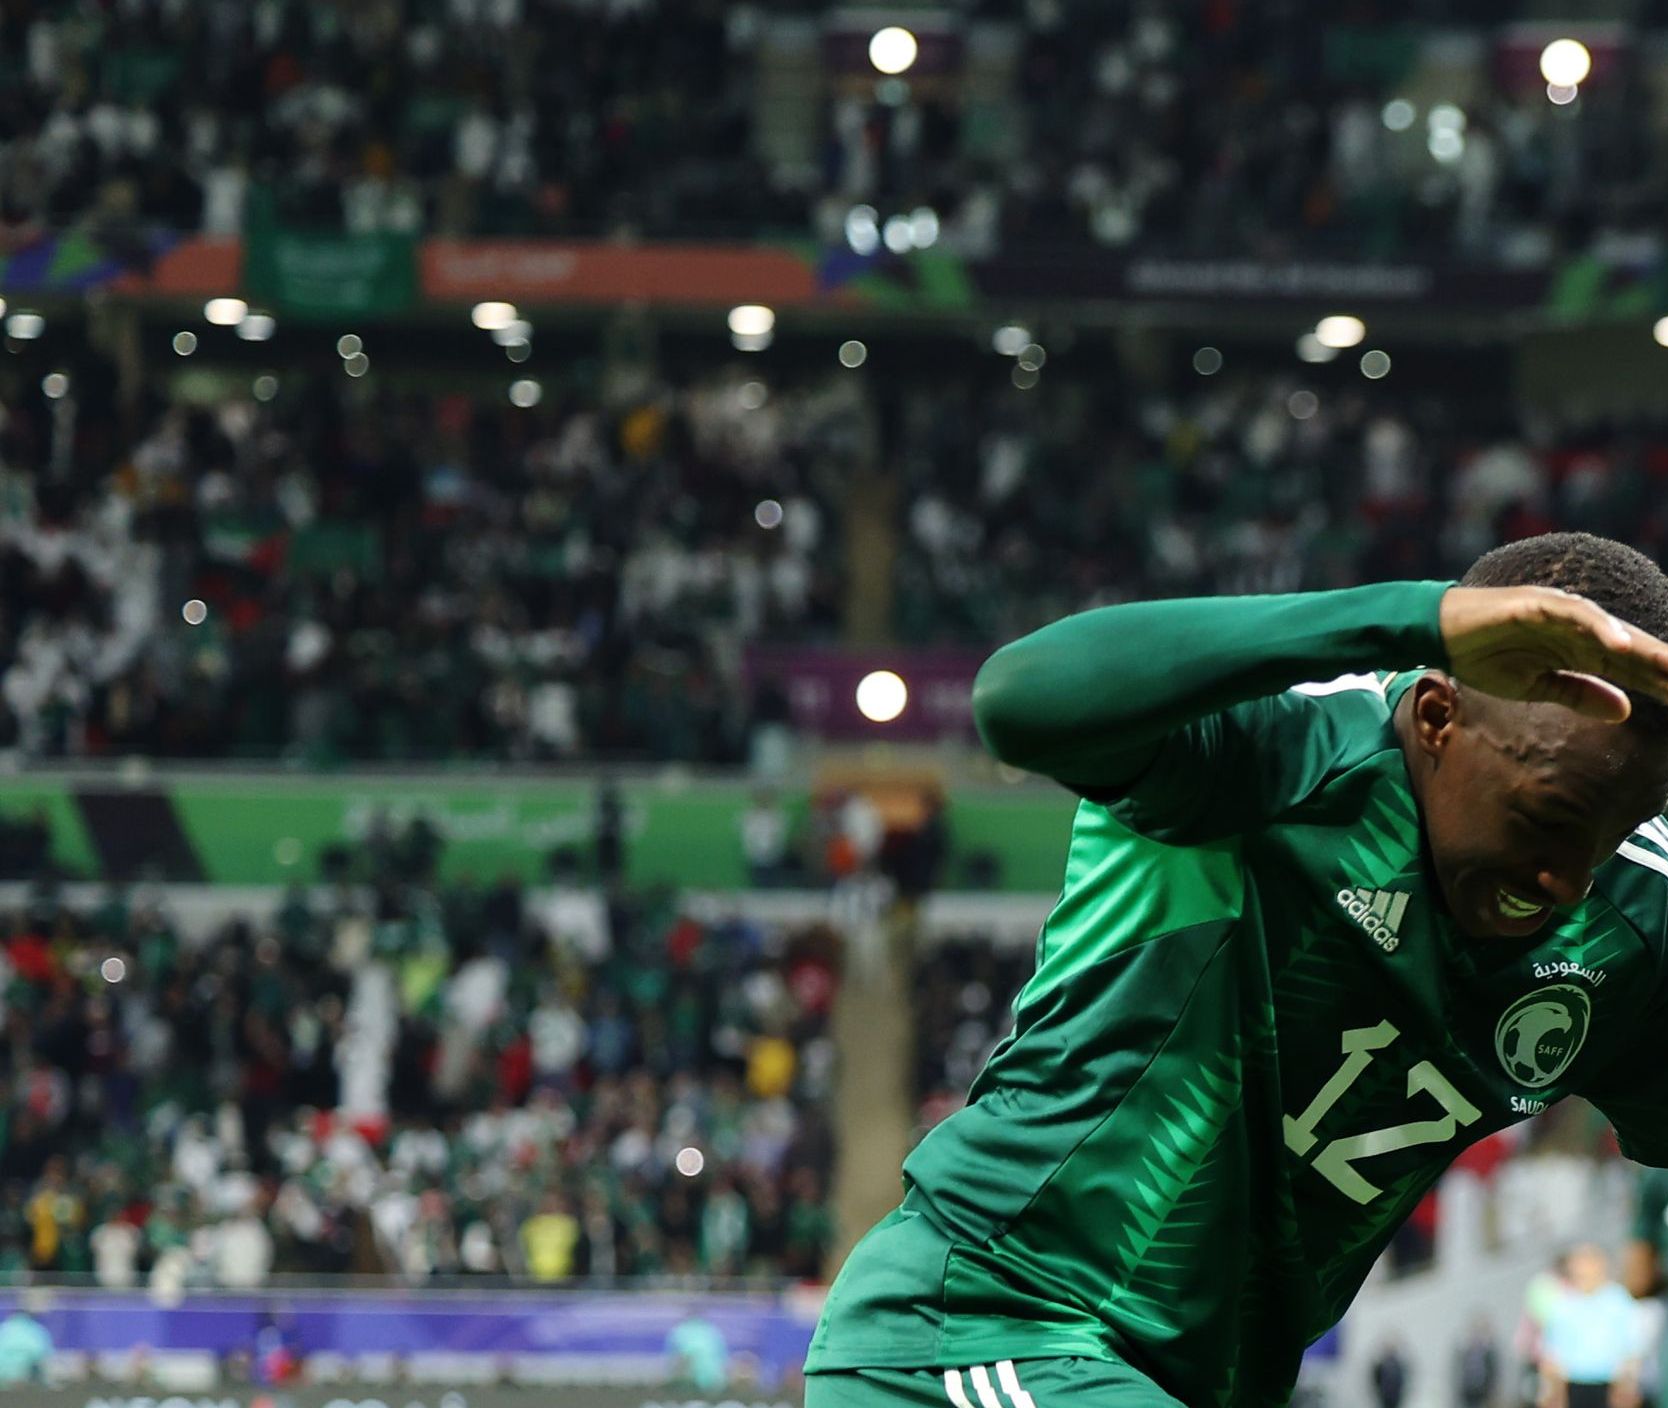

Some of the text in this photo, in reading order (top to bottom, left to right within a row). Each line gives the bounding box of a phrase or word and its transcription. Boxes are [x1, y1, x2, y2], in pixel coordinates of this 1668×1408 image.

[1337, 889, 1400, 953] adidas
[1532, 960, 1608, 988] السعودية
[1537, 1044, 1564, 1057] SAFF
[1282, 1018, 1484, 1206] 12
[1510, 1096, 1549, 1116] SAUD
